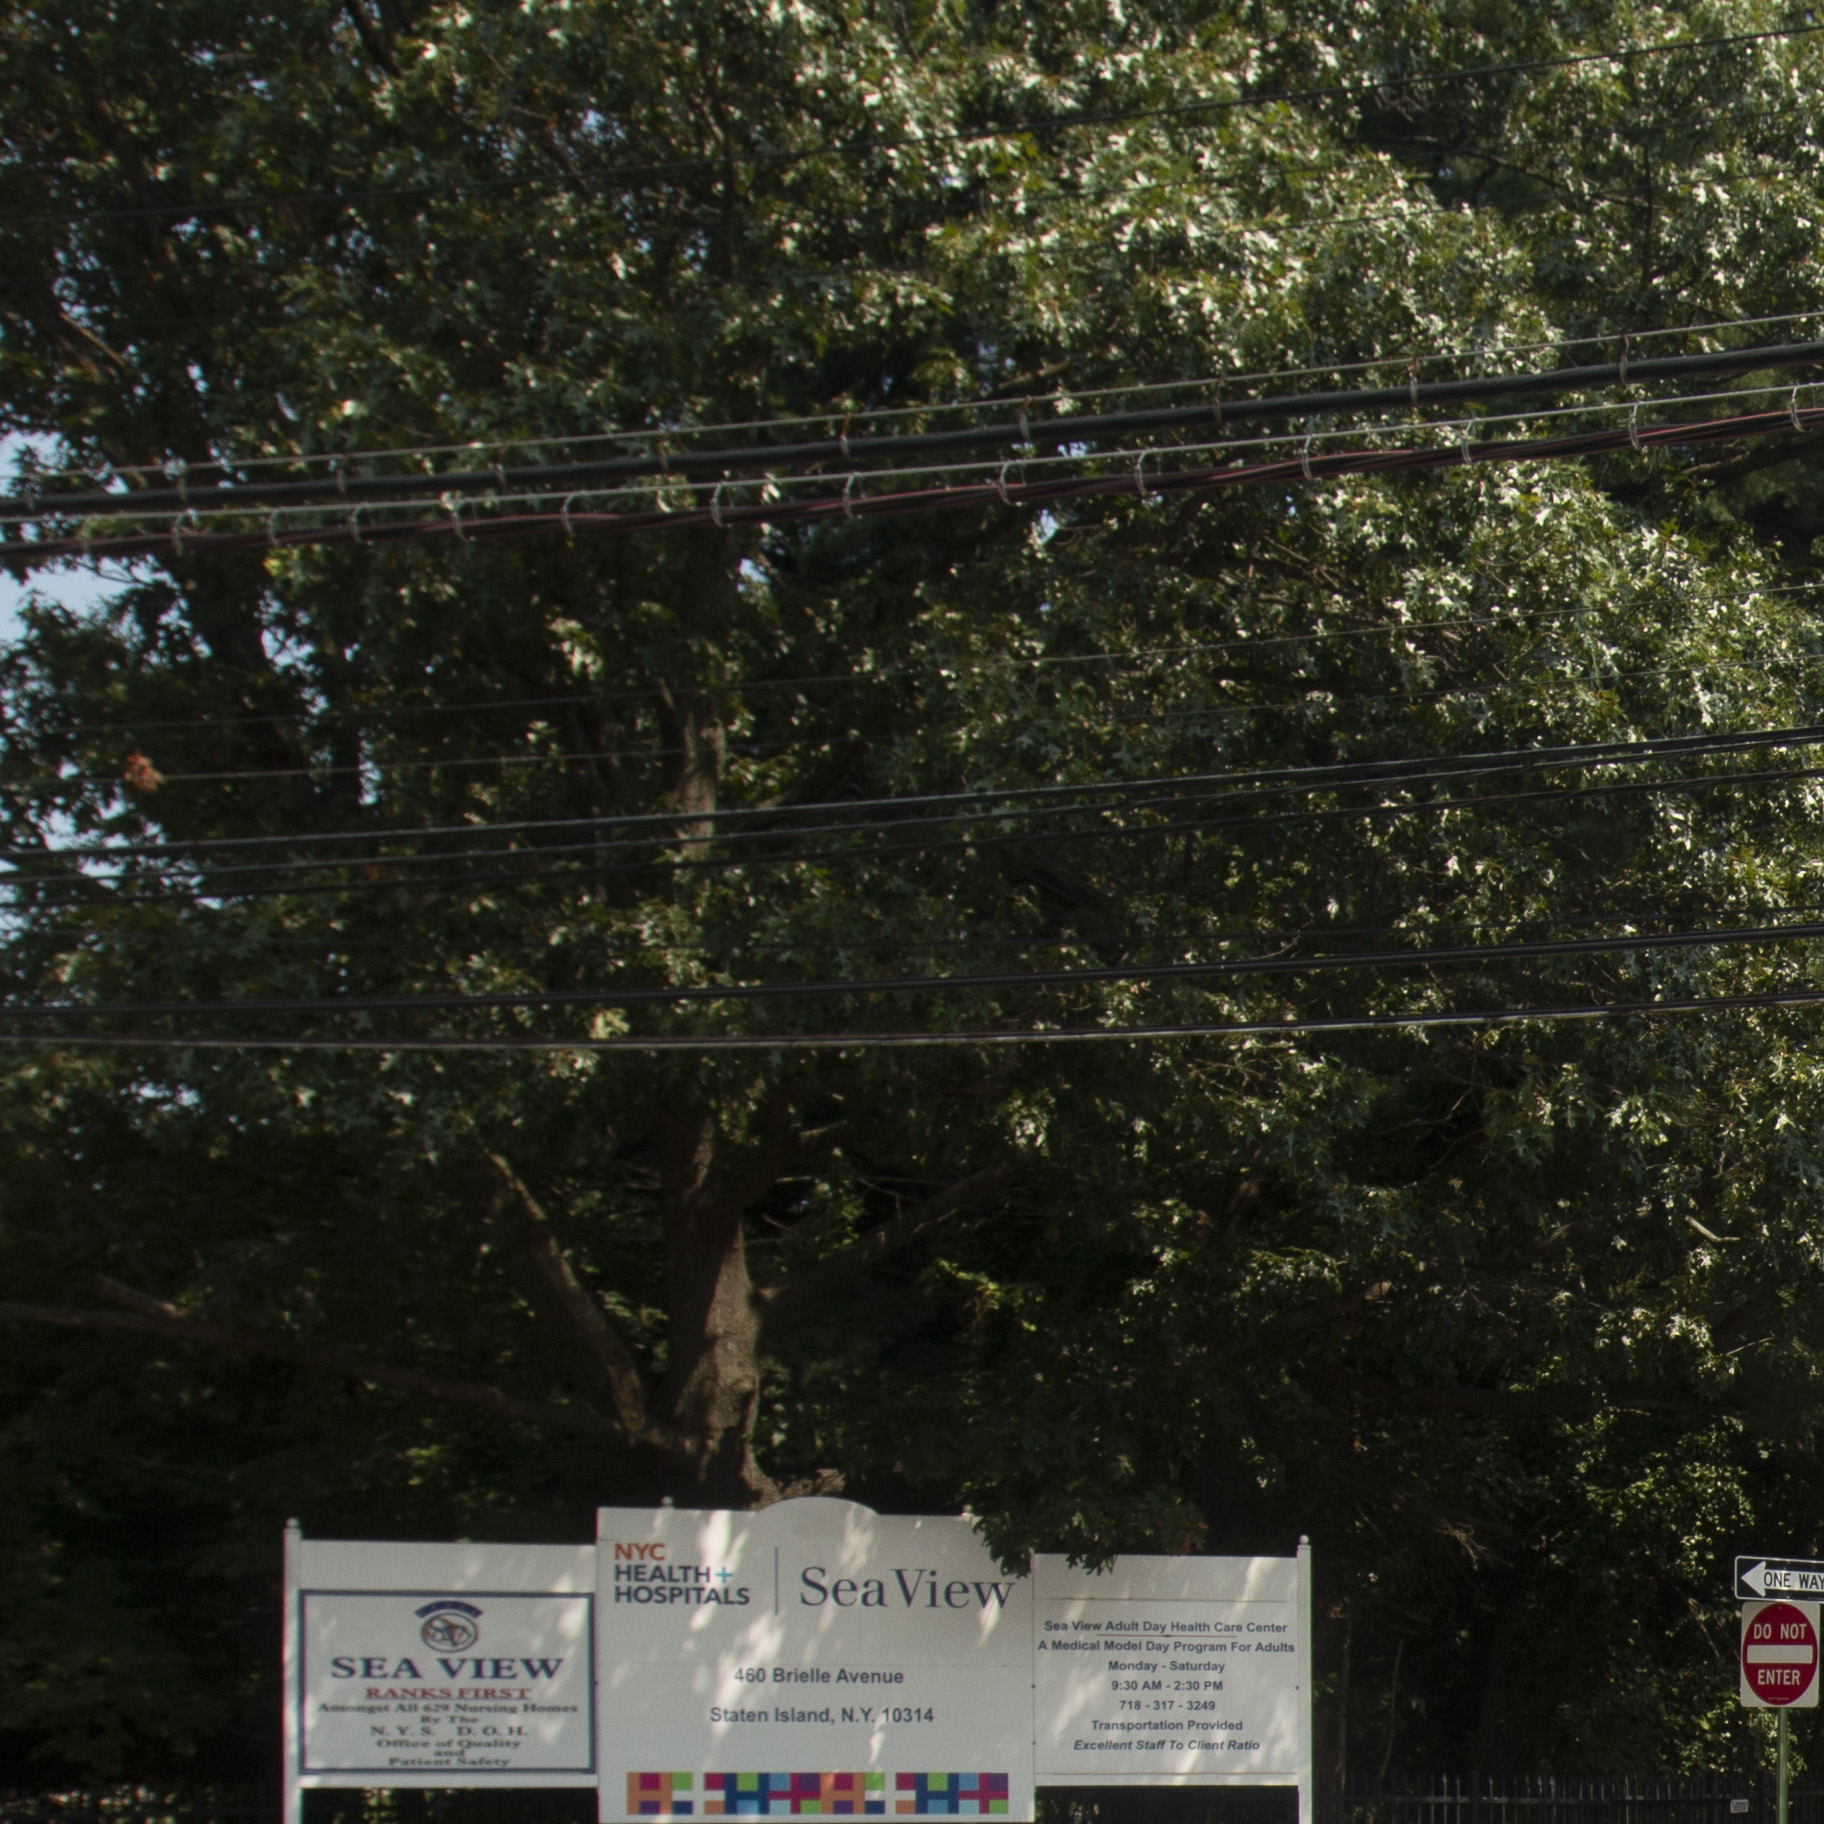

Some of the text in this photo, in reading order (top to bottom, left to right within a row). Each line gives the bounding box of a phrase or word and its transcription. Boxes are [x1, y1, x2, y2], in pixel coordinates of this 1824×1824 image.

[614, 1543, 666, 1561] NYC
[1764, 1571, 1791, 1588] ONE
[614, 1586, 749, 1605] HOSPITALS
[1044, 1621, 1287, 1634] Sea View Adult Day Health Care Center
[1753, 1624, 1807, 1639] DO NOT
[1038, 1641, 1295, 1653] A Medical Model Day Program For Adults
[331, 1657, 563, 1680] SEA VIEW
[1108, 1661, 1158, 1673] Monday
[1170, 1661, 1225, 1673] Saturday
[733, 1668, 905, 1684] 460 Brielle Avenue
[1757, 1669, 1801, 1685] ENTER
[1111, 1681, 1138, 1691] 9:30
[1142, 1681, 1162, 1691] AM
[1173, 1681, 1200, 1691] 2:30
[1204, 1681, 1223, 1691] PM
[366, 1687, 531, 1699] RANKS FIRST
[319, 1703, 389, 1714] Amongst
[396, 1703, 418, 1712] All
[454, 1703, 517, 1714] Nursing
[522, 1703, 578, 1713] Homes
[1119, 1700, 1141, 1710] 718
[1153, 1700, 1174, 1710] 317
[1186, 1700, 1216, 1711] 3249
[421, 1715, 478, 1725] By The
[710, 1707, 934, 1726] Staten Island, N.Y. 10314
[1091, 1720, 1243, 1733] Transportation Provided
[376, 1739, 521, 1750] Office of Quality
[1073, 1740, 1260, 1751] Excellent Staff To Client Ratio
[434, 1749, 465, 1757] and
[389, 1757, 510, 1768] Patient Safety
